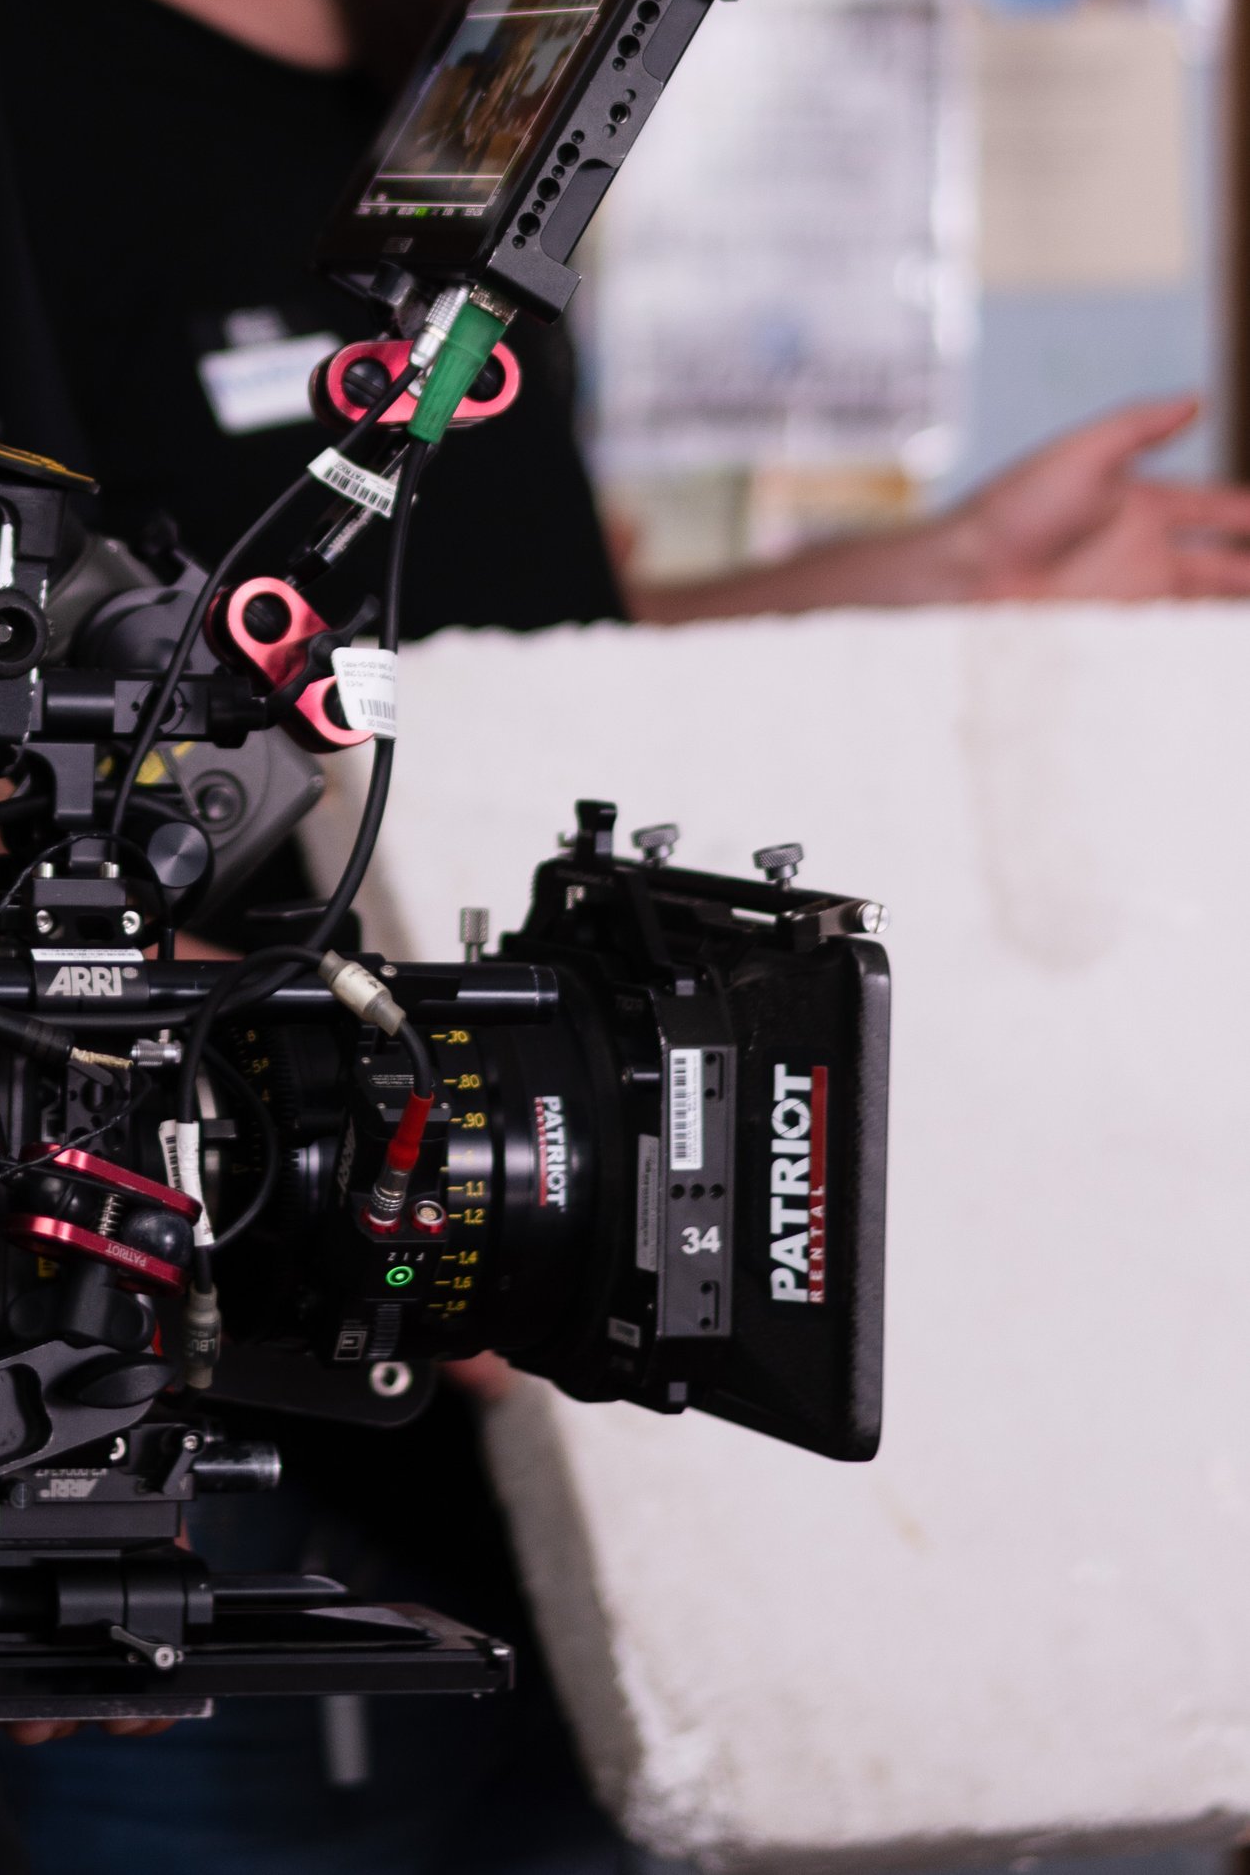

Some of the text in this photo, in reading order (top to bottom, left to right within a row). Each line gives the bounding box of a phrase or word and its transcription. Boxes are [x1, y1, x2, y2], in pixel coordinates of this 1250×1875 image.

[45, 966, 123, 996] ARRI
[461, 1112, 486, 1128] .90
[543, 1095, 567, 1207] PATRIOT
[464, 1180, 486, 1197] 1.1
[770, 1063, 813, 1303] PATRIOT
[464, 1208, 486, 1224] 1.2
[681, 1226, 722, 1255] 34
[809, 1185, 826, 1302] RENTAL
[105, 1242, 148, 1268] PATRIOT
[50, 1478, 99, 1498] ARRI
